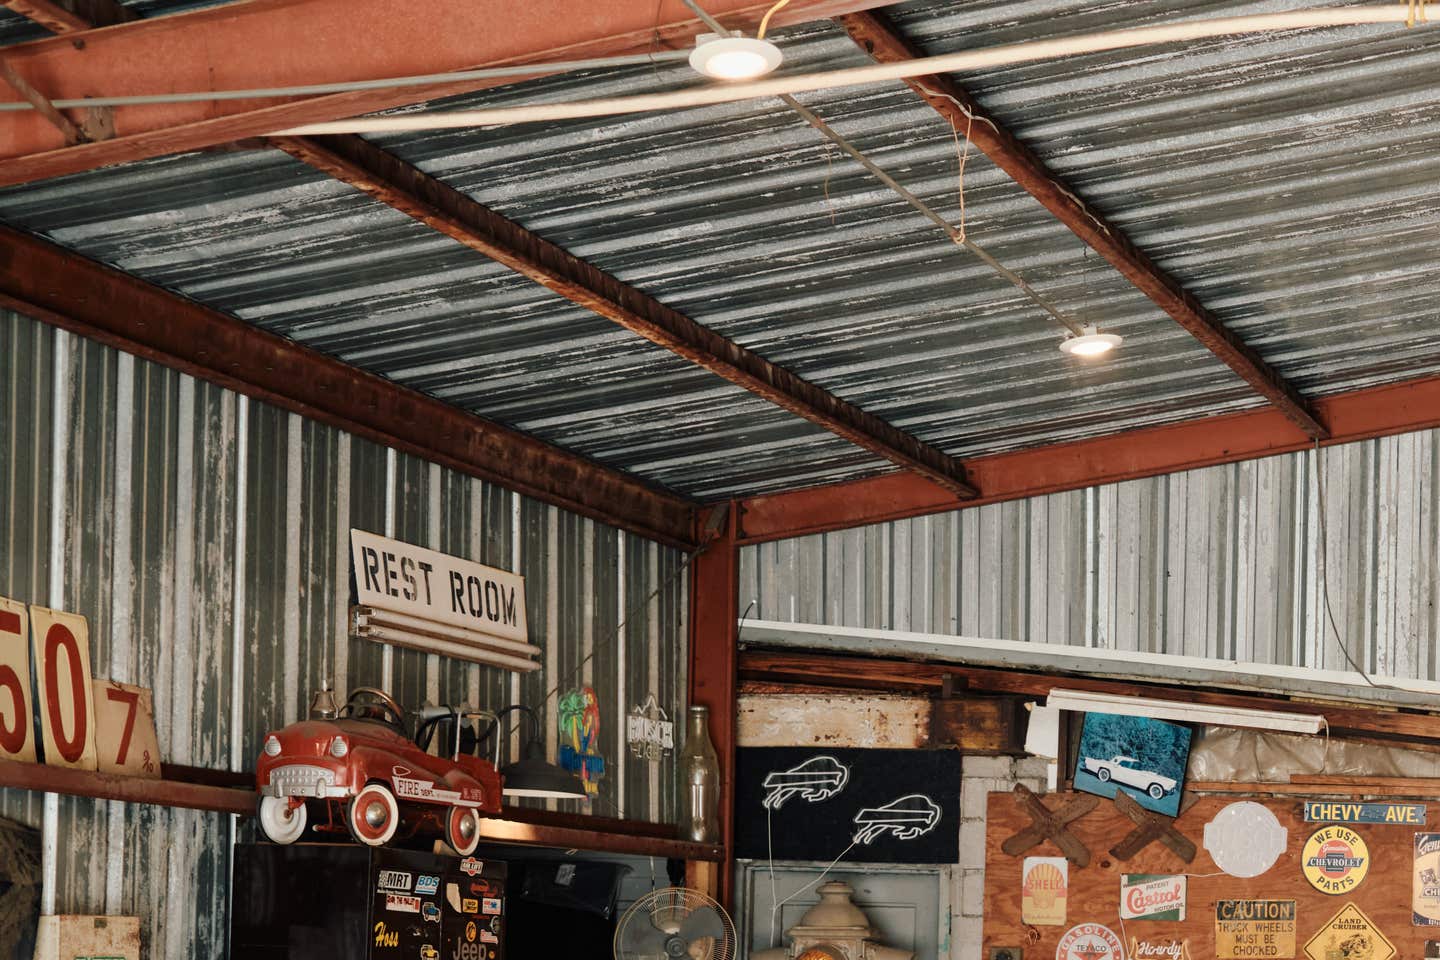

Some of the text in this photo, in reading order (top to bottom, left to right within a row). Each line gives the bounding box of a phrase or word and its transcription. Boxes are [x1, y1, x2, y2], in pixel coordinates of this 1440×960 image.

[362, 546, 517, 627] REST ROOM
[398, 780, 420, 796] FIRE
[1311, 803, 1419, 822] CHEVY AVE.
[1314, 828, 1359, 846] WE USE
[1310, 857, 1362, 867] CHEVROLET
[387, 873, 409, 888] MRT
[418, 876, 440, 887] BDS
[1028, 879, 1060, 890] SHELL
[1316, 875, 1354, 891] PARTS
[1126, 883, 1181, 914] Castrol
[1222, 903, 1290, 919] CAUTION
[1218, 922, 1294, 933] TRUCK WHEELS
[1062, 926, 1121, 952] GASOLINE
[1235, 934, 1275, 944] MUST BE
[1076, 944, 1107, 952] TEXACO
[1138, 940, 1182, 960] Howdy
[1233, 945, 1278, 956] CHOCKED
